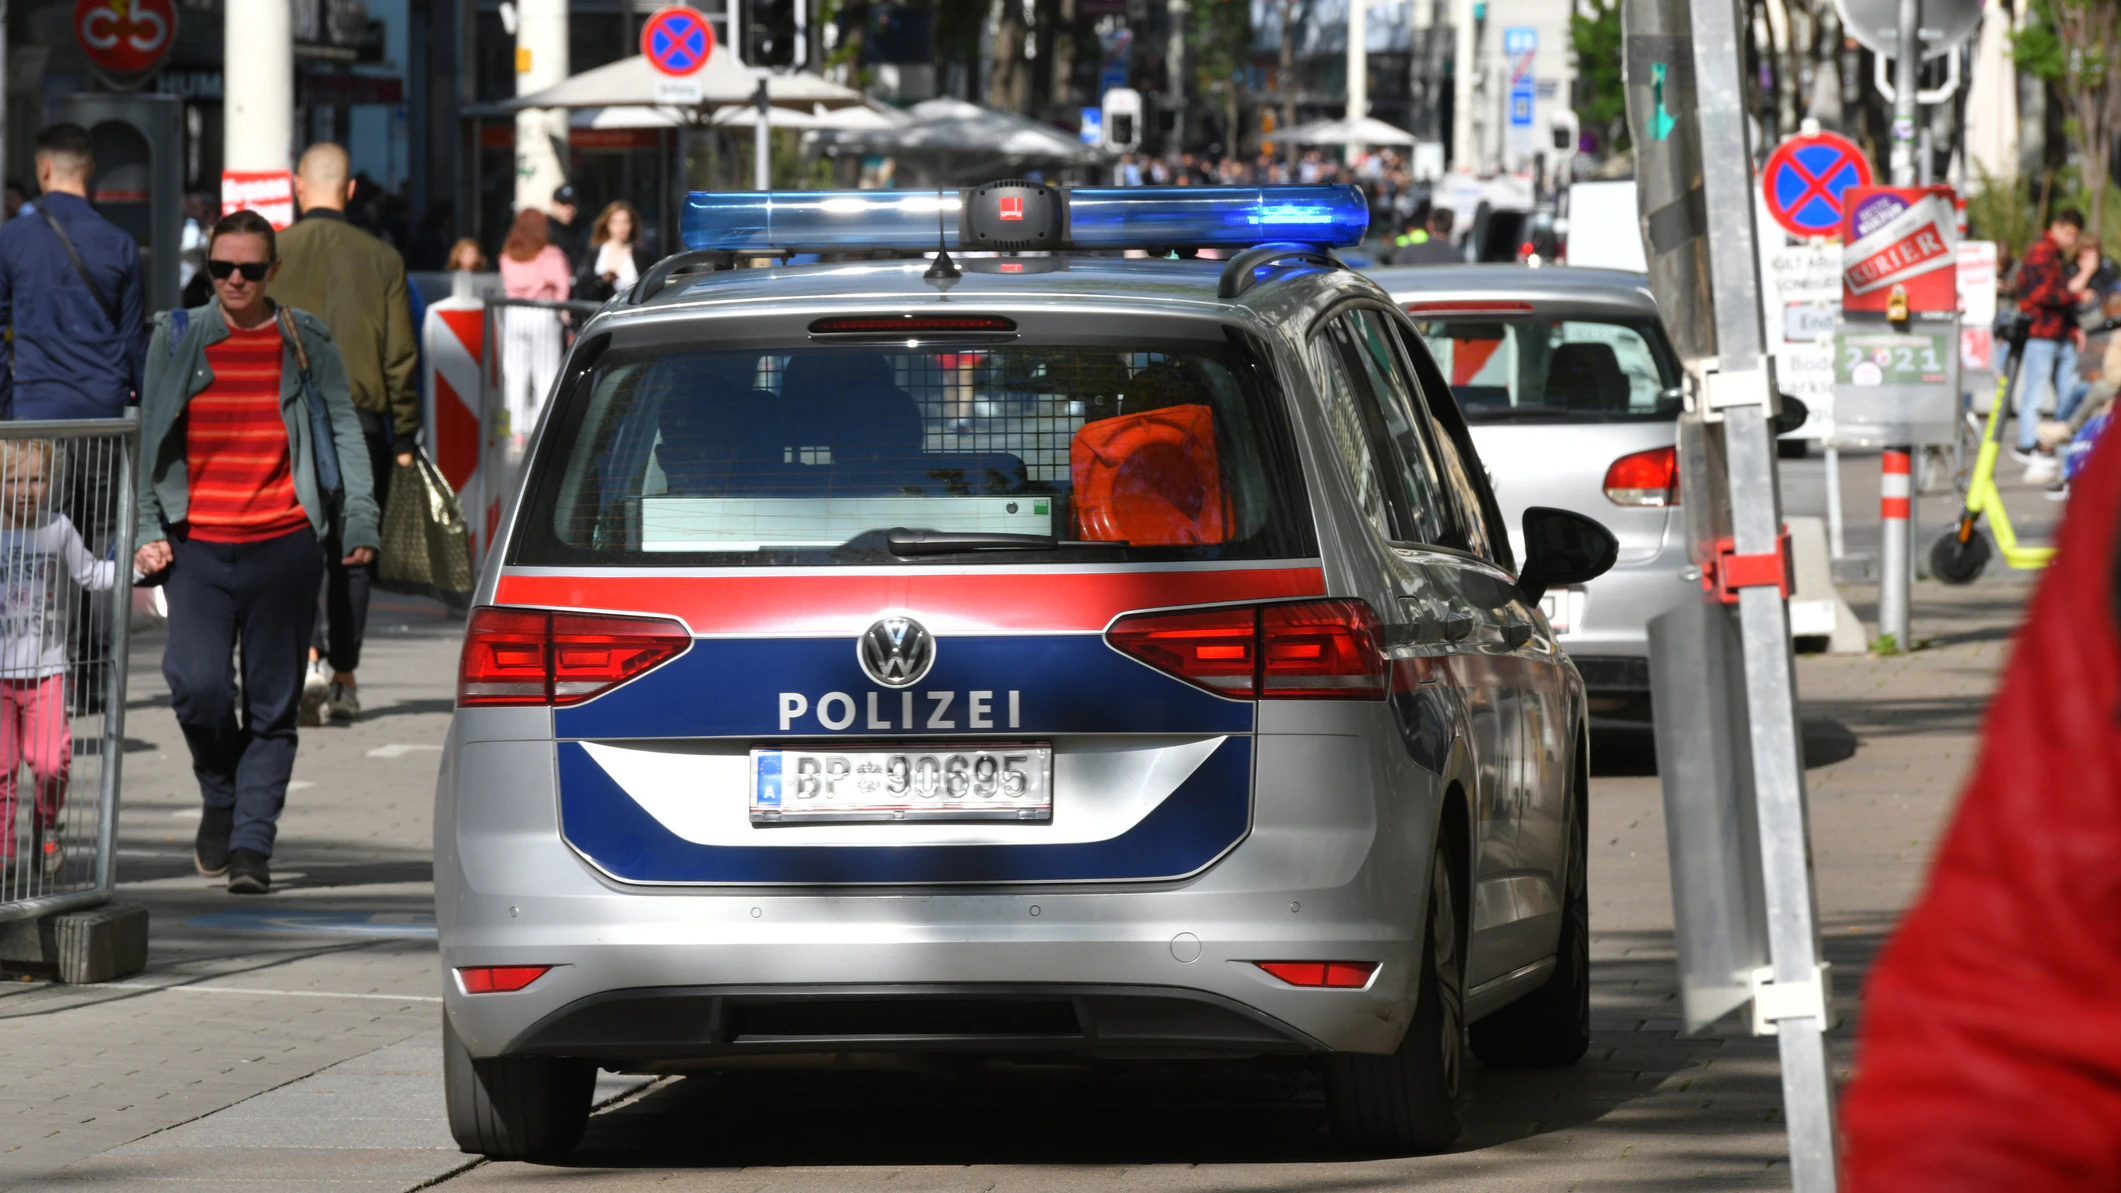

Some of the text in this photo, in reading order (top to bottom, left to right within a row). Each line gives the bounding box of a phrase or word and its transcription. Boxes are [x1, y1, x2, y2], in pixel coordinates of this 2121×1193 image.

[1851, 231, 1942, 284] KURIER
[779, 690, 1020, 730] POLIZEI
[797, 756, 850, 799] BP
[886, 754, 1029, 798] 90695
